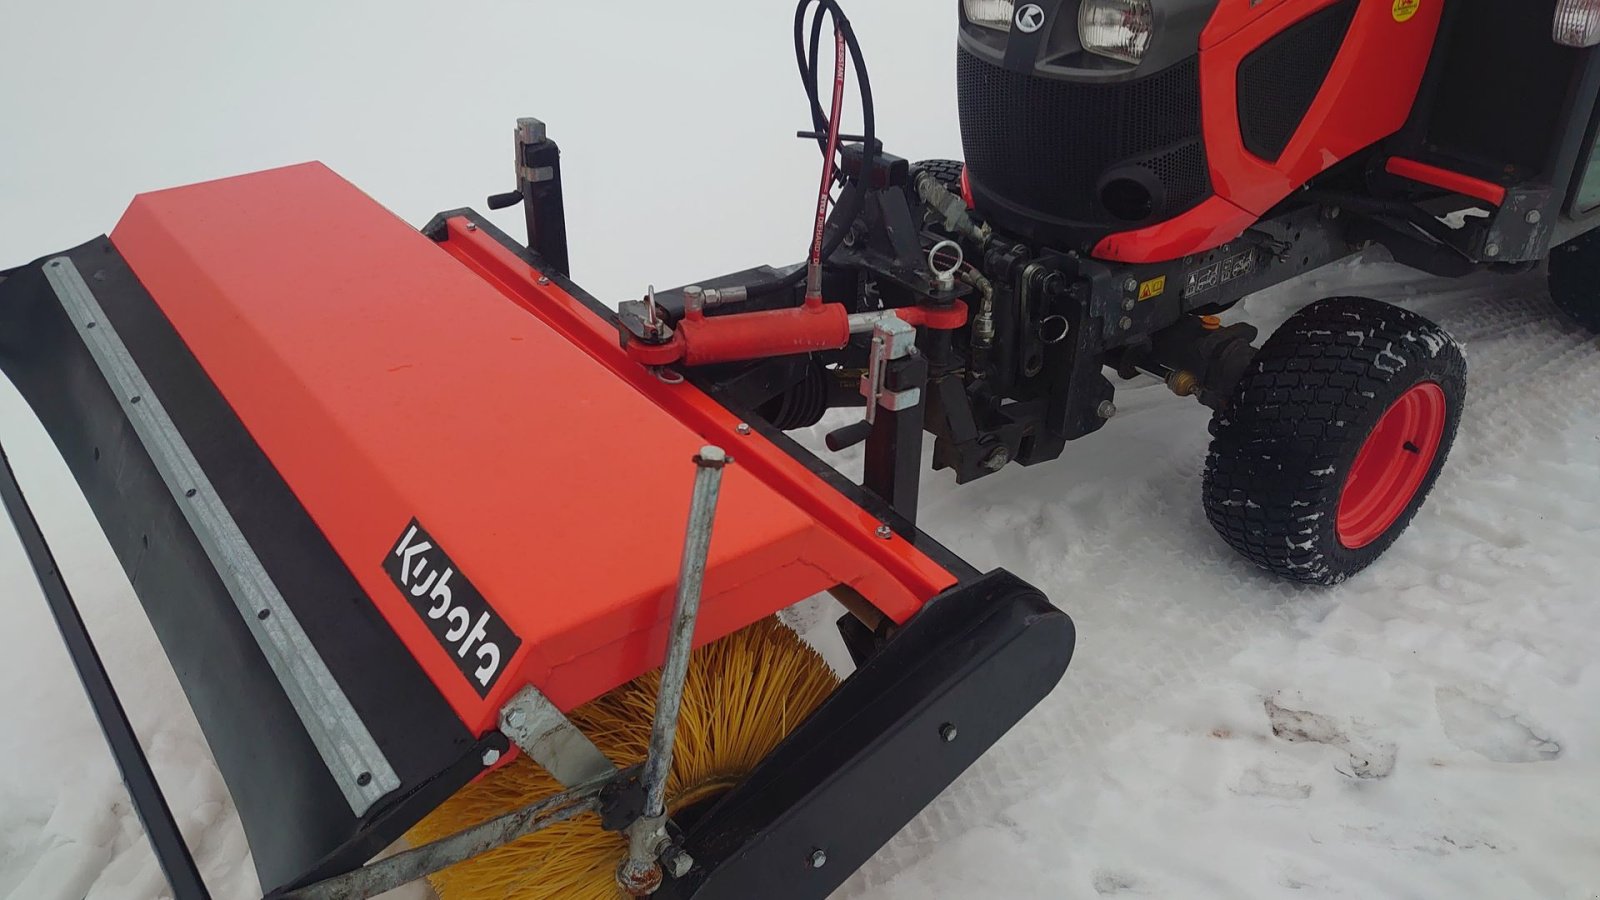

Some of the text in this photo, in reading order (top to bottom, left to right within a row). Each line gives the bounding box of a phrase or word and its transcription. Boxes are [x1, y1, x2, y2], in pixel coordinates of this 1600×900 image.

[836, 42, 845, 81] RESISTANT
[814, 216, 824, 252] DIEHARD
[395, 525, 501, 687] Kubota
